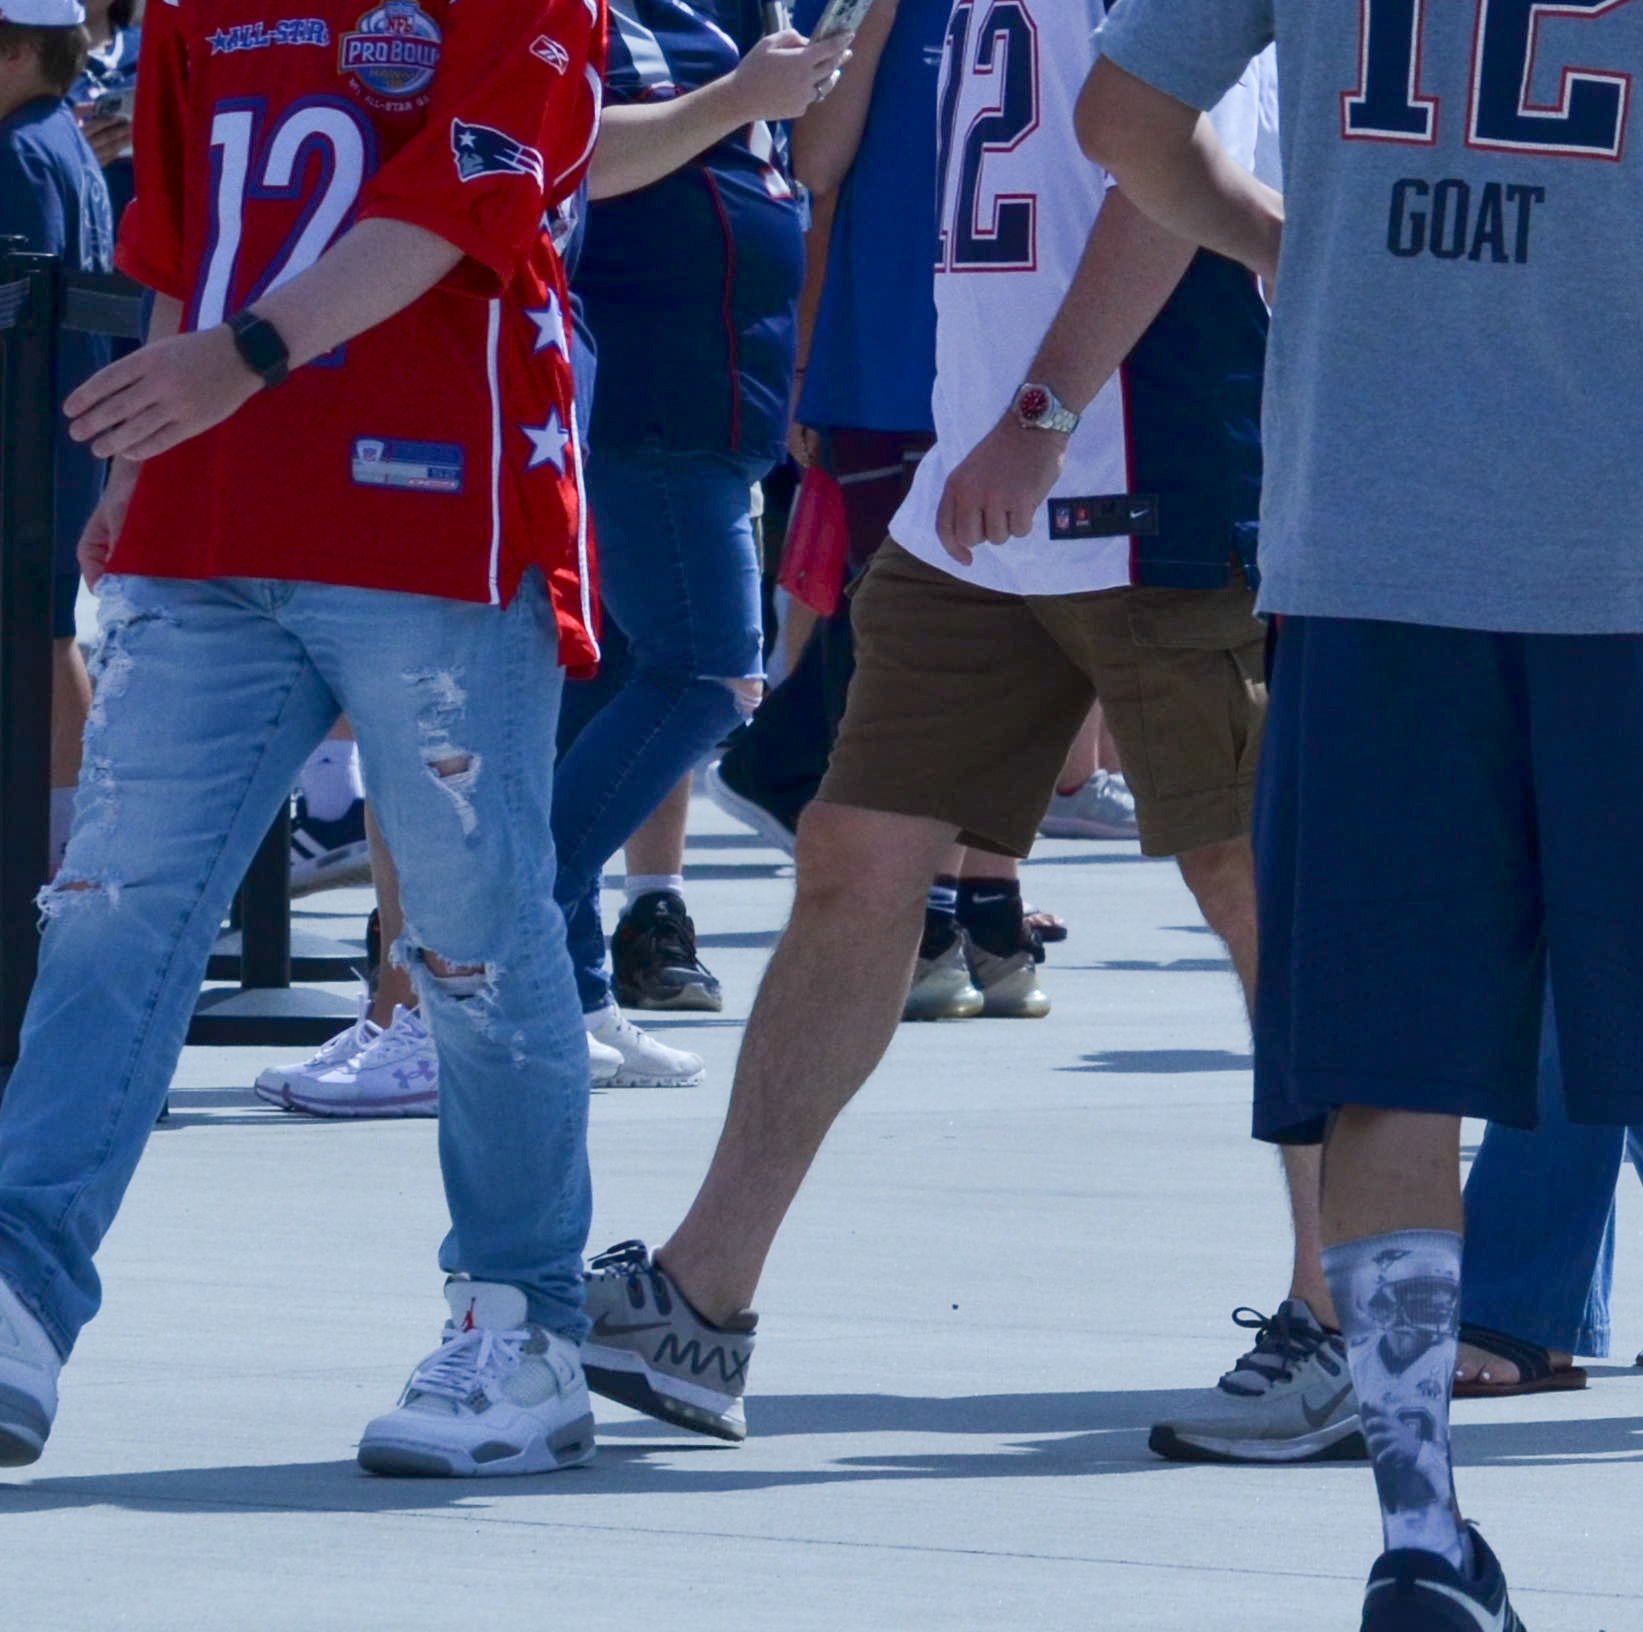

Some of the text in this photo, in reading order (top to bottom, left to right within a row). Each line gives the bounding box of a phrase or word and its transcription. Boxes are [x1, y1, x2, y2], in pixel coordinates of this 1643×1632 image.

[348, 41, 389, 64] PRO
[183, 94, 380, 366] 12
[1386, 177, 1546, 265] GOAT
